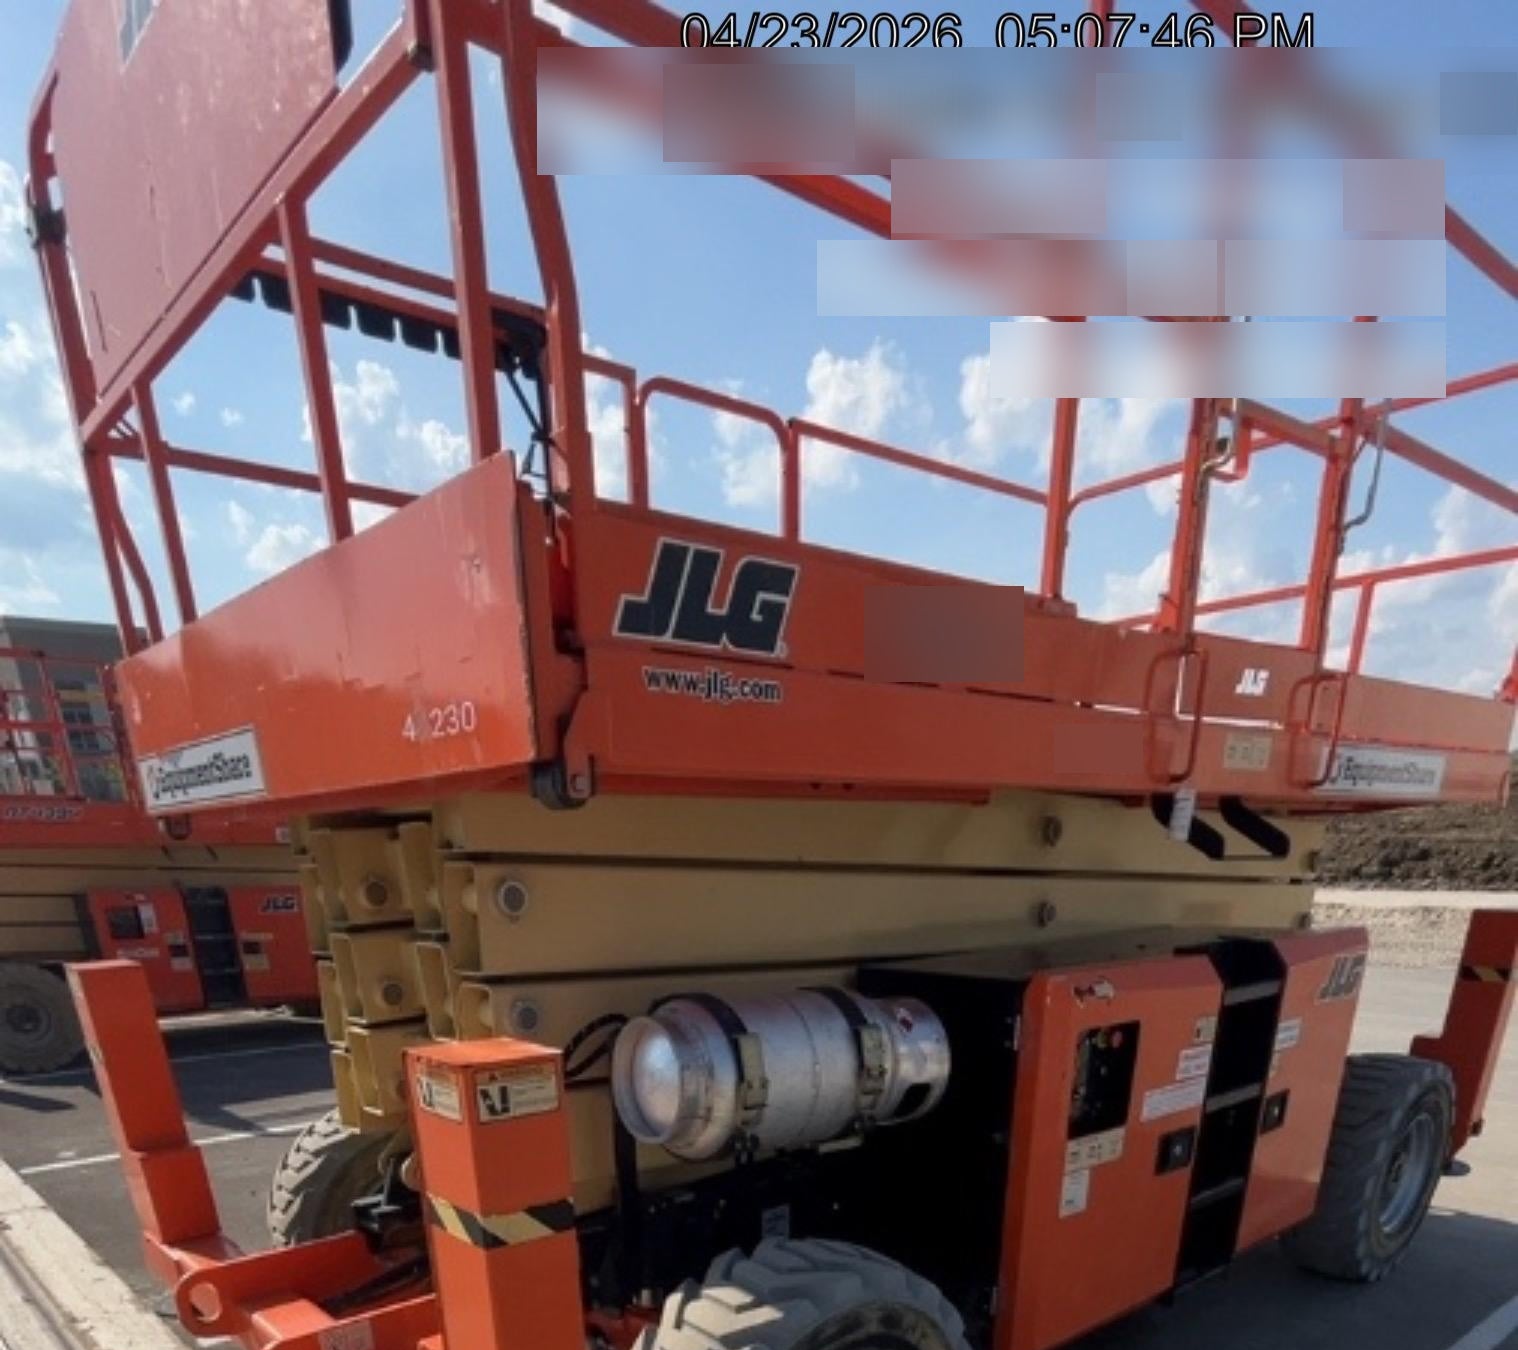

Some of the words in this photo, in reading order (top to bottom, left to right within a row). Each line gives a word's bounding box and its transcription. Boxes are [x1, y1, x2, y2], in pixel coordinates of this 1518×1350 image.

[612, 537, 799, 658] JLG
[643, 665, 781, 704] www.jlg.com
[1235, 668, 1269, 696] JLG
[401, 701, 475, 742] 4230
[259, 895, 298, 913] JLG
[1315, 953, 1367, 1002] JLG
